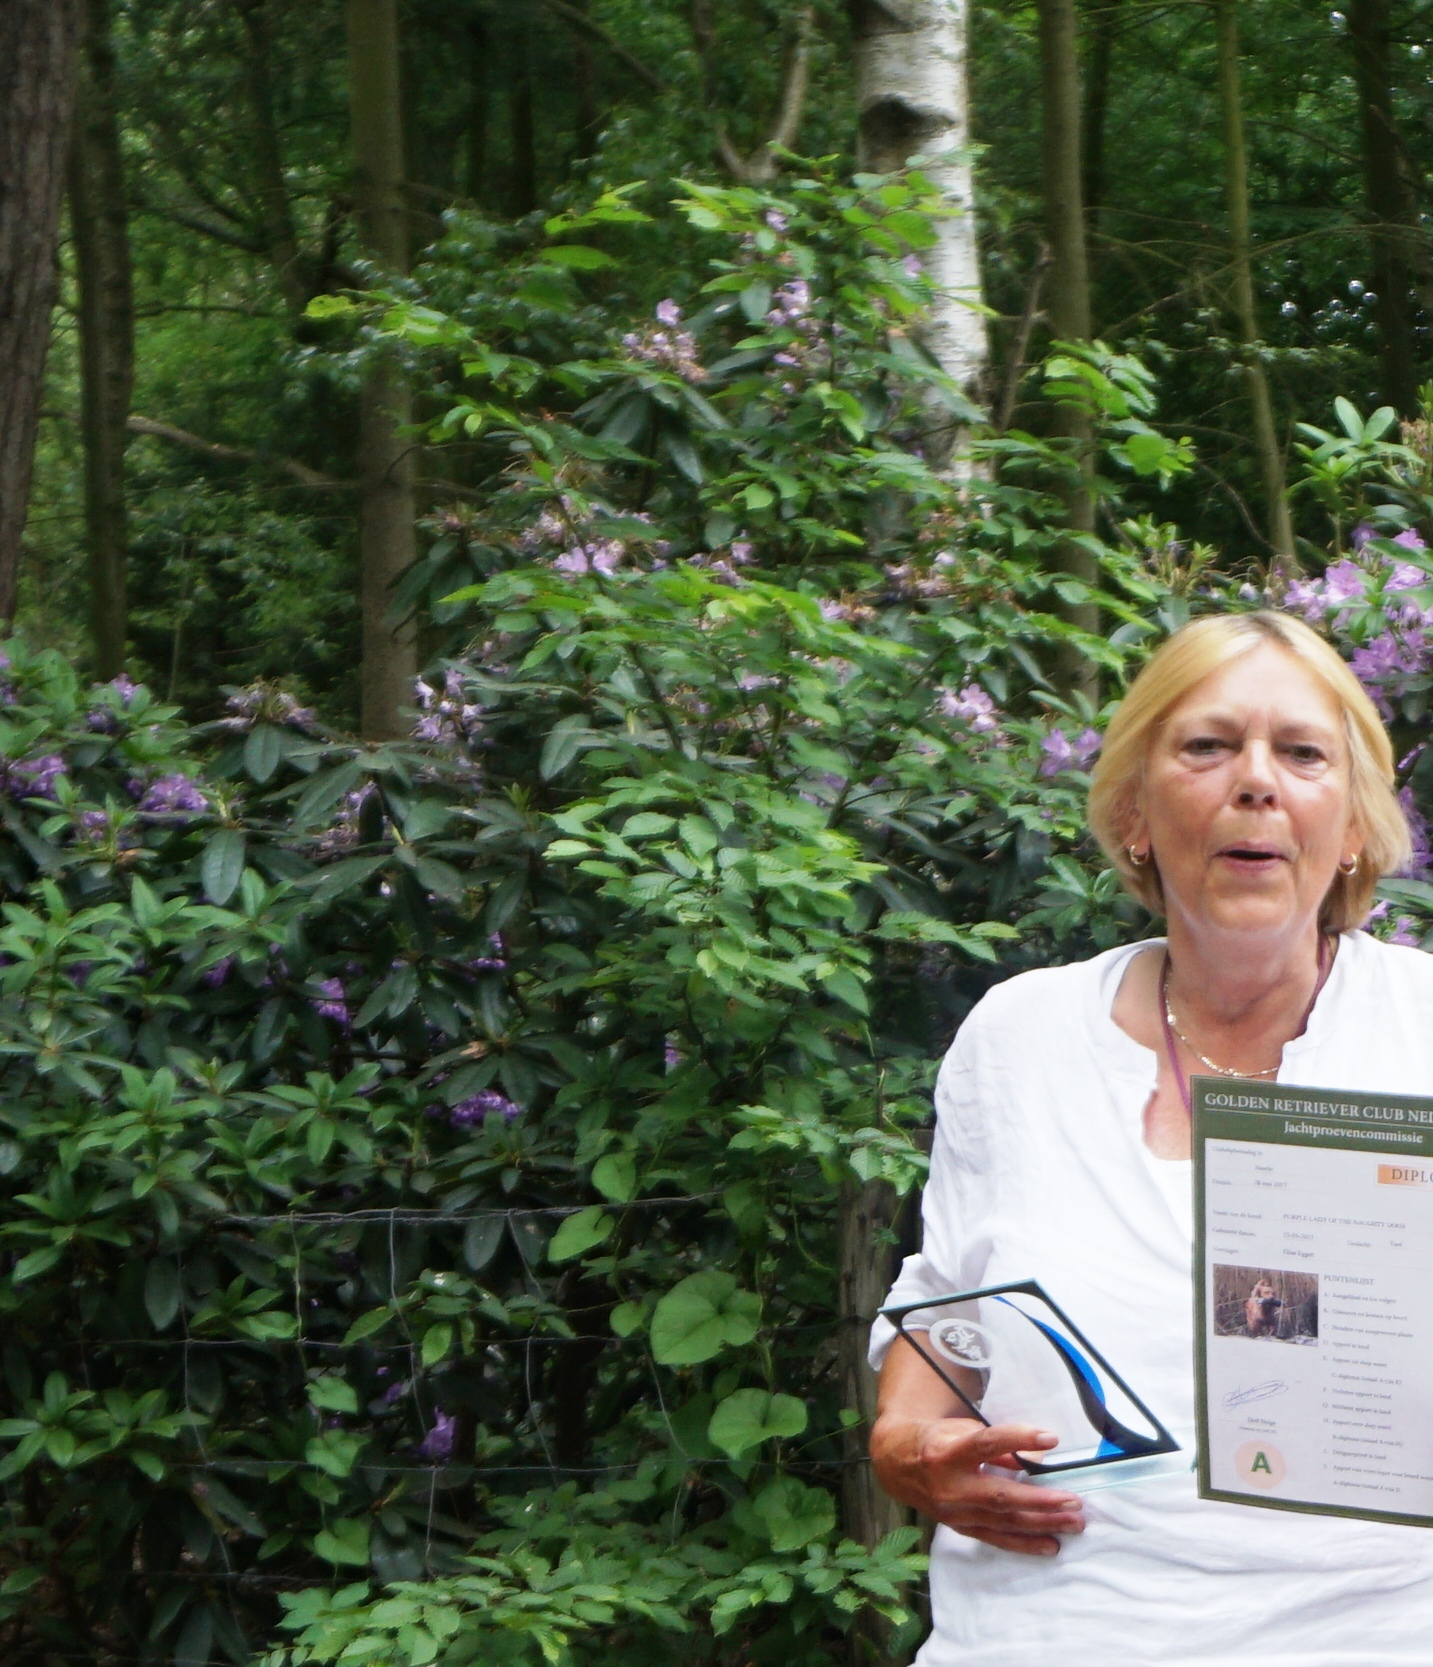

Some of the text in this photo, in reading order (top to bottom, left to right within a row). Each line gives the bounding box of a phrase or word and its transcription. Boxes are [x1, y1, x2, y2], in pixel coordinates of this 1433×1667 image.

[1205, 1093, 1269, 1109] GOLDEN
[1274, 1098, 1359, 1117] RETRIEVER
[1363, 1105, 1404, 1120] CLUB
[1284, 1121, 1423, 1143] Jachtproevencommissie
[1251, 1451, 1272, 1475] A
